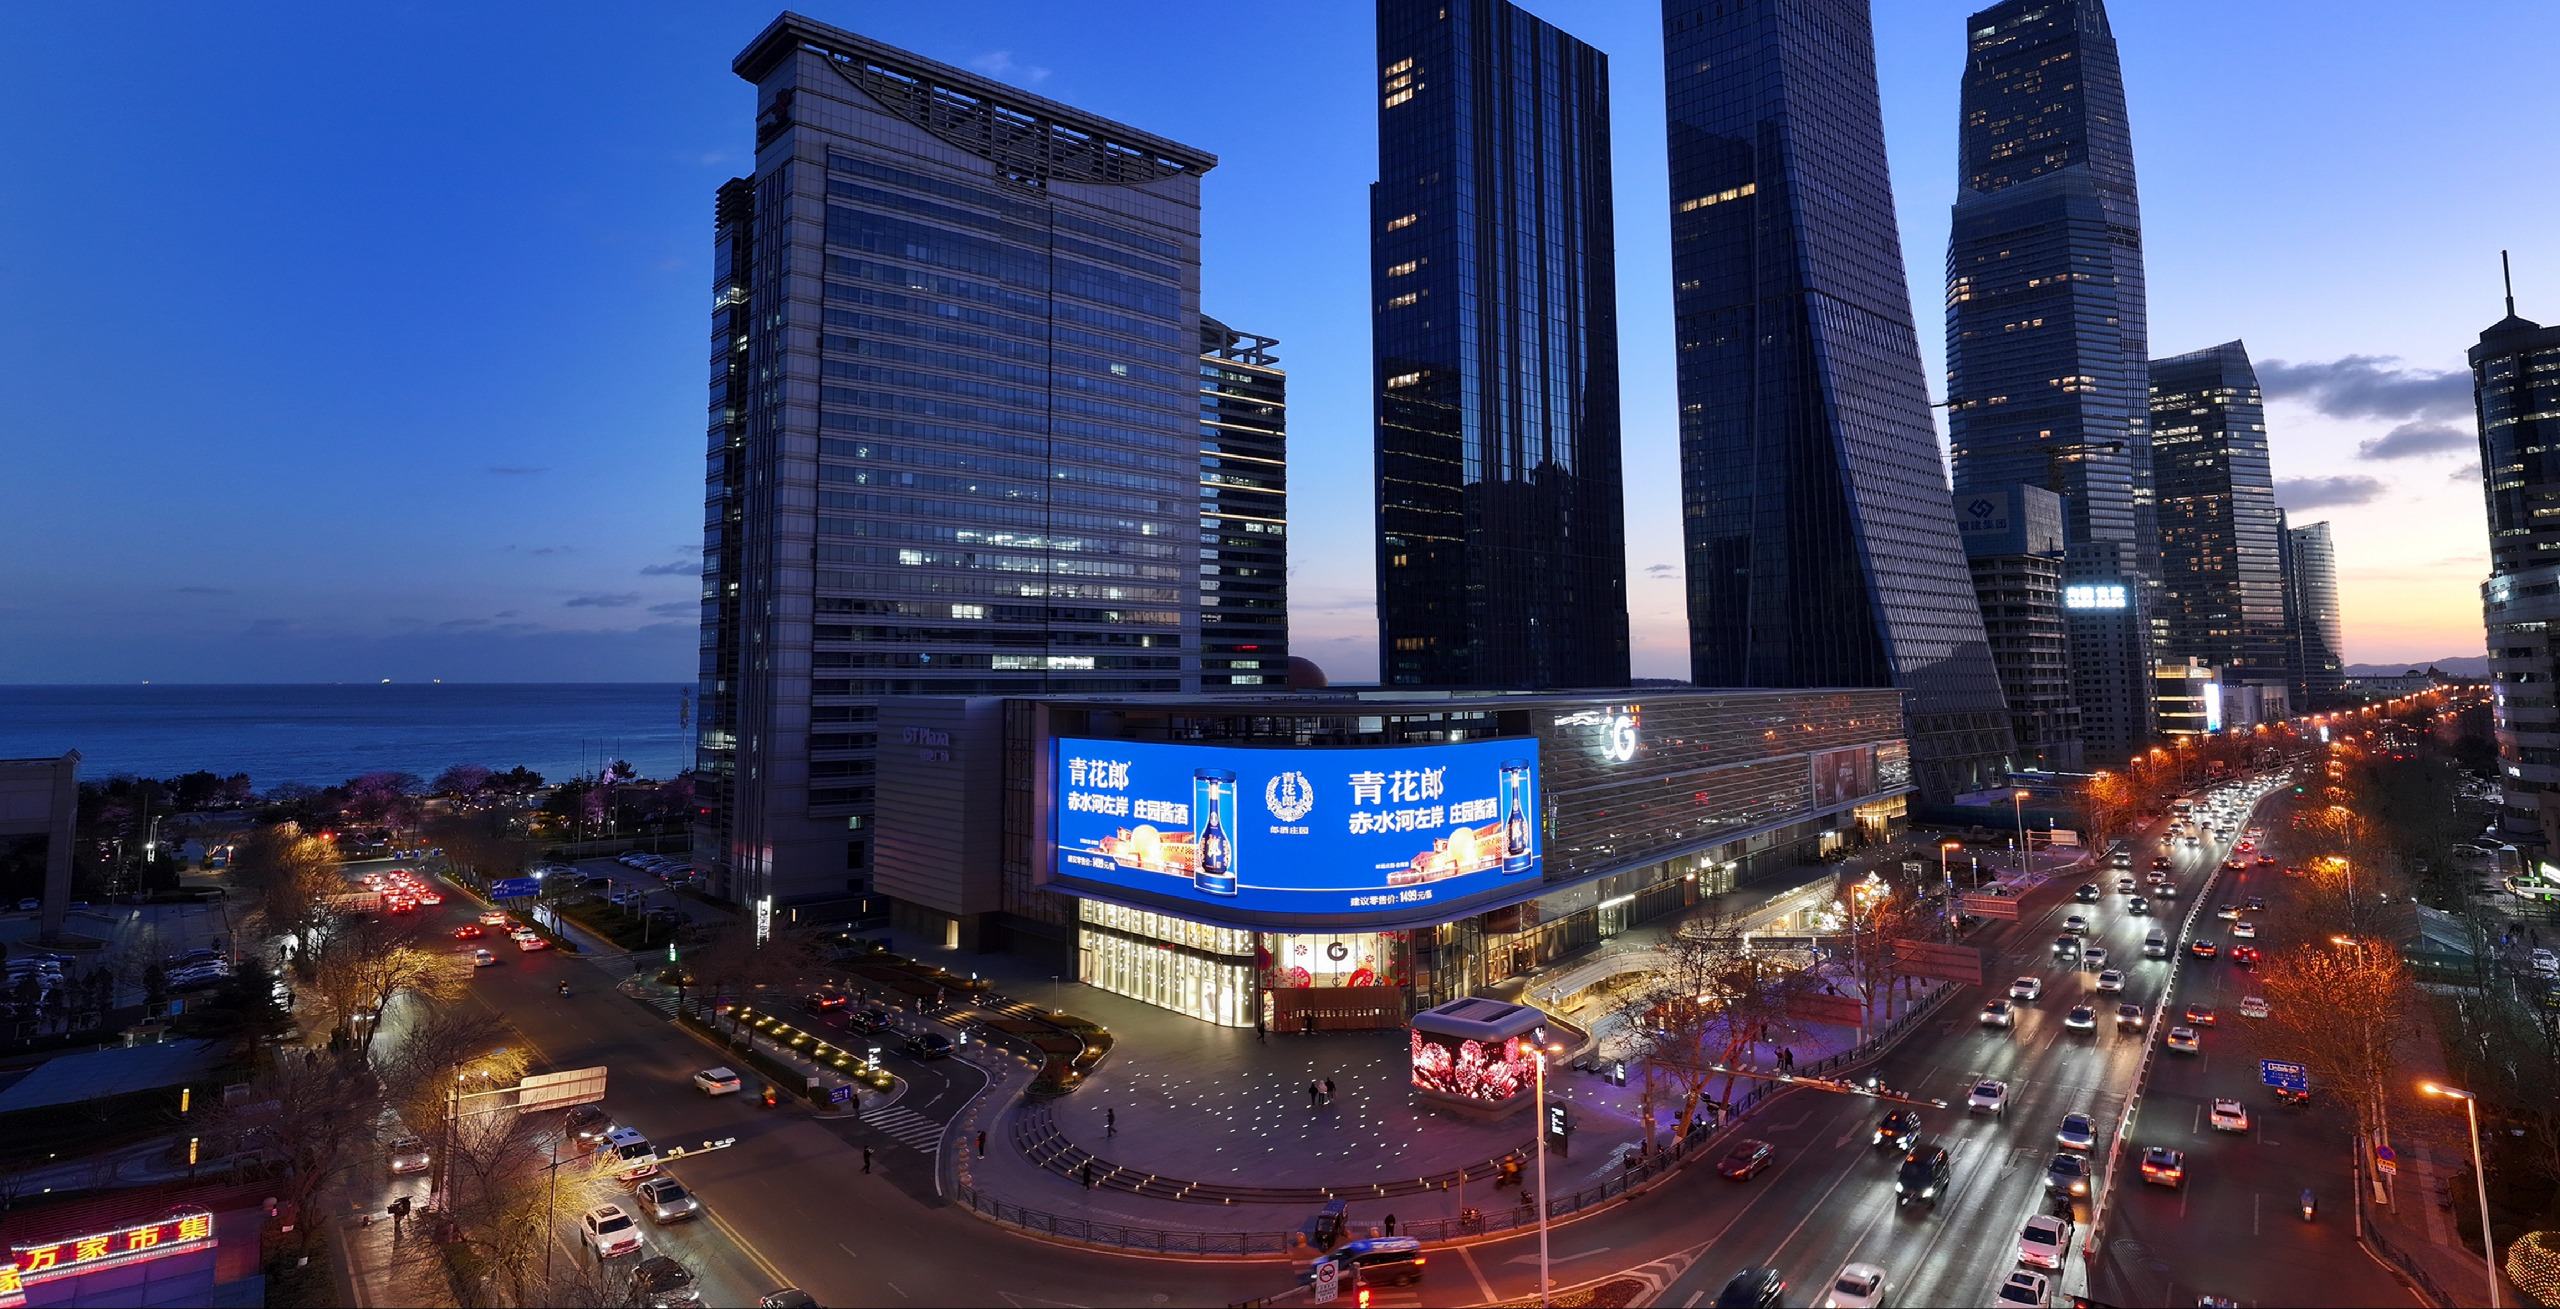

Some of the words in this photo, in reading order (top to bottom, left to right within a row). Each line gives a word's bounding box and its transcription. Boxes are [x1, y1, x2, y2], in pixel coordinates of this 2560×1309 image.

[920, 728, 949, 746] Plaza
[1069, 757, 1129, 791] 青花郎
[1348, 767, 1444, 805] 青花郎
[1068, 791, 1129, 817] 赤水河左岸
[1134, 799, 1189, 825] 庄园酱酒
[1349, 805, 1444, 834] 赤水河左岸
[1450, 797, 1498, 824] 庄园酱酒
[27, 1217, 207, 1271] 万家市集
